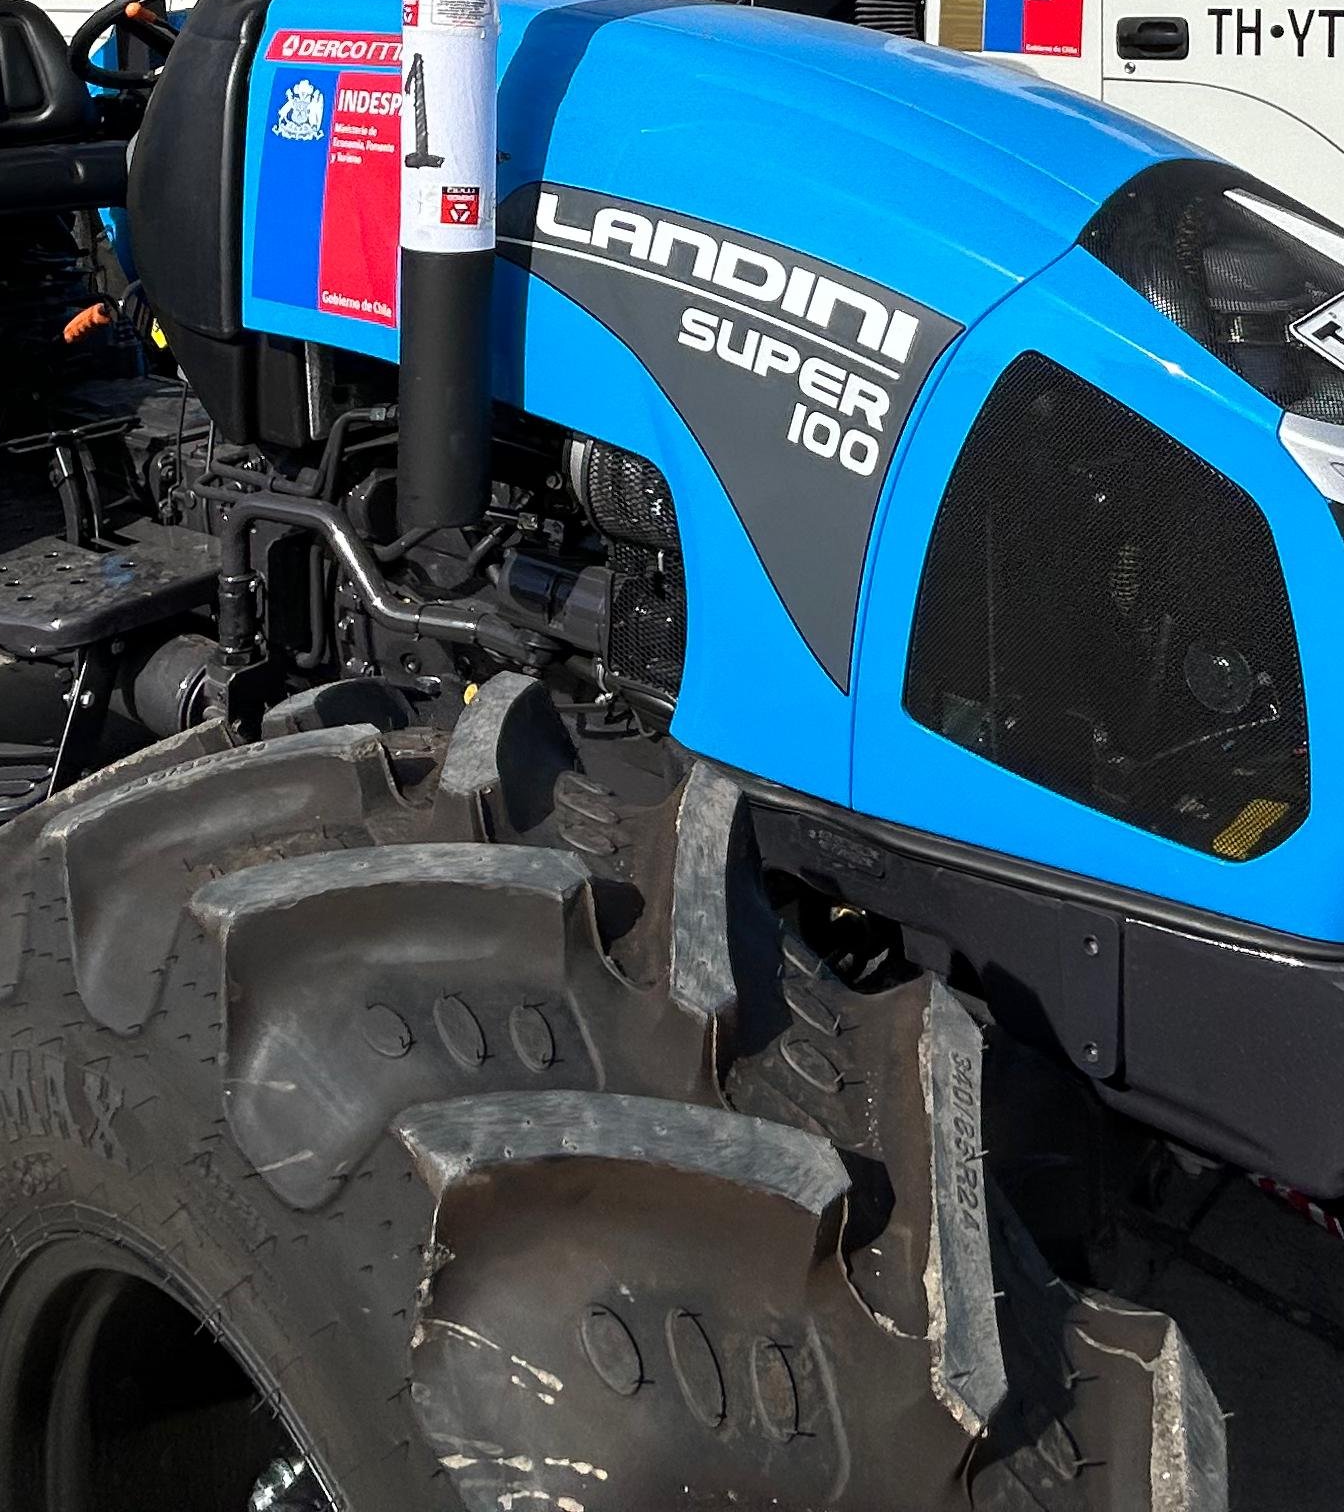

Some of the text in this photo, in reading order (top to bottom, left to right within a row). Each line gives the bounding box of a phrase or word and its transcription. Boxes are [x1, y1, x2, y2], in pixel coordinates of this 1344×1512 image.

[337, 88, 402, 117] INDESP
[321, 290, 393, 318] Gobierno de Chile
[535, 190, 921, 364] LANDINI
[677, 307, 892, 433] SUPER
[786, 401, 880, 477] 100
